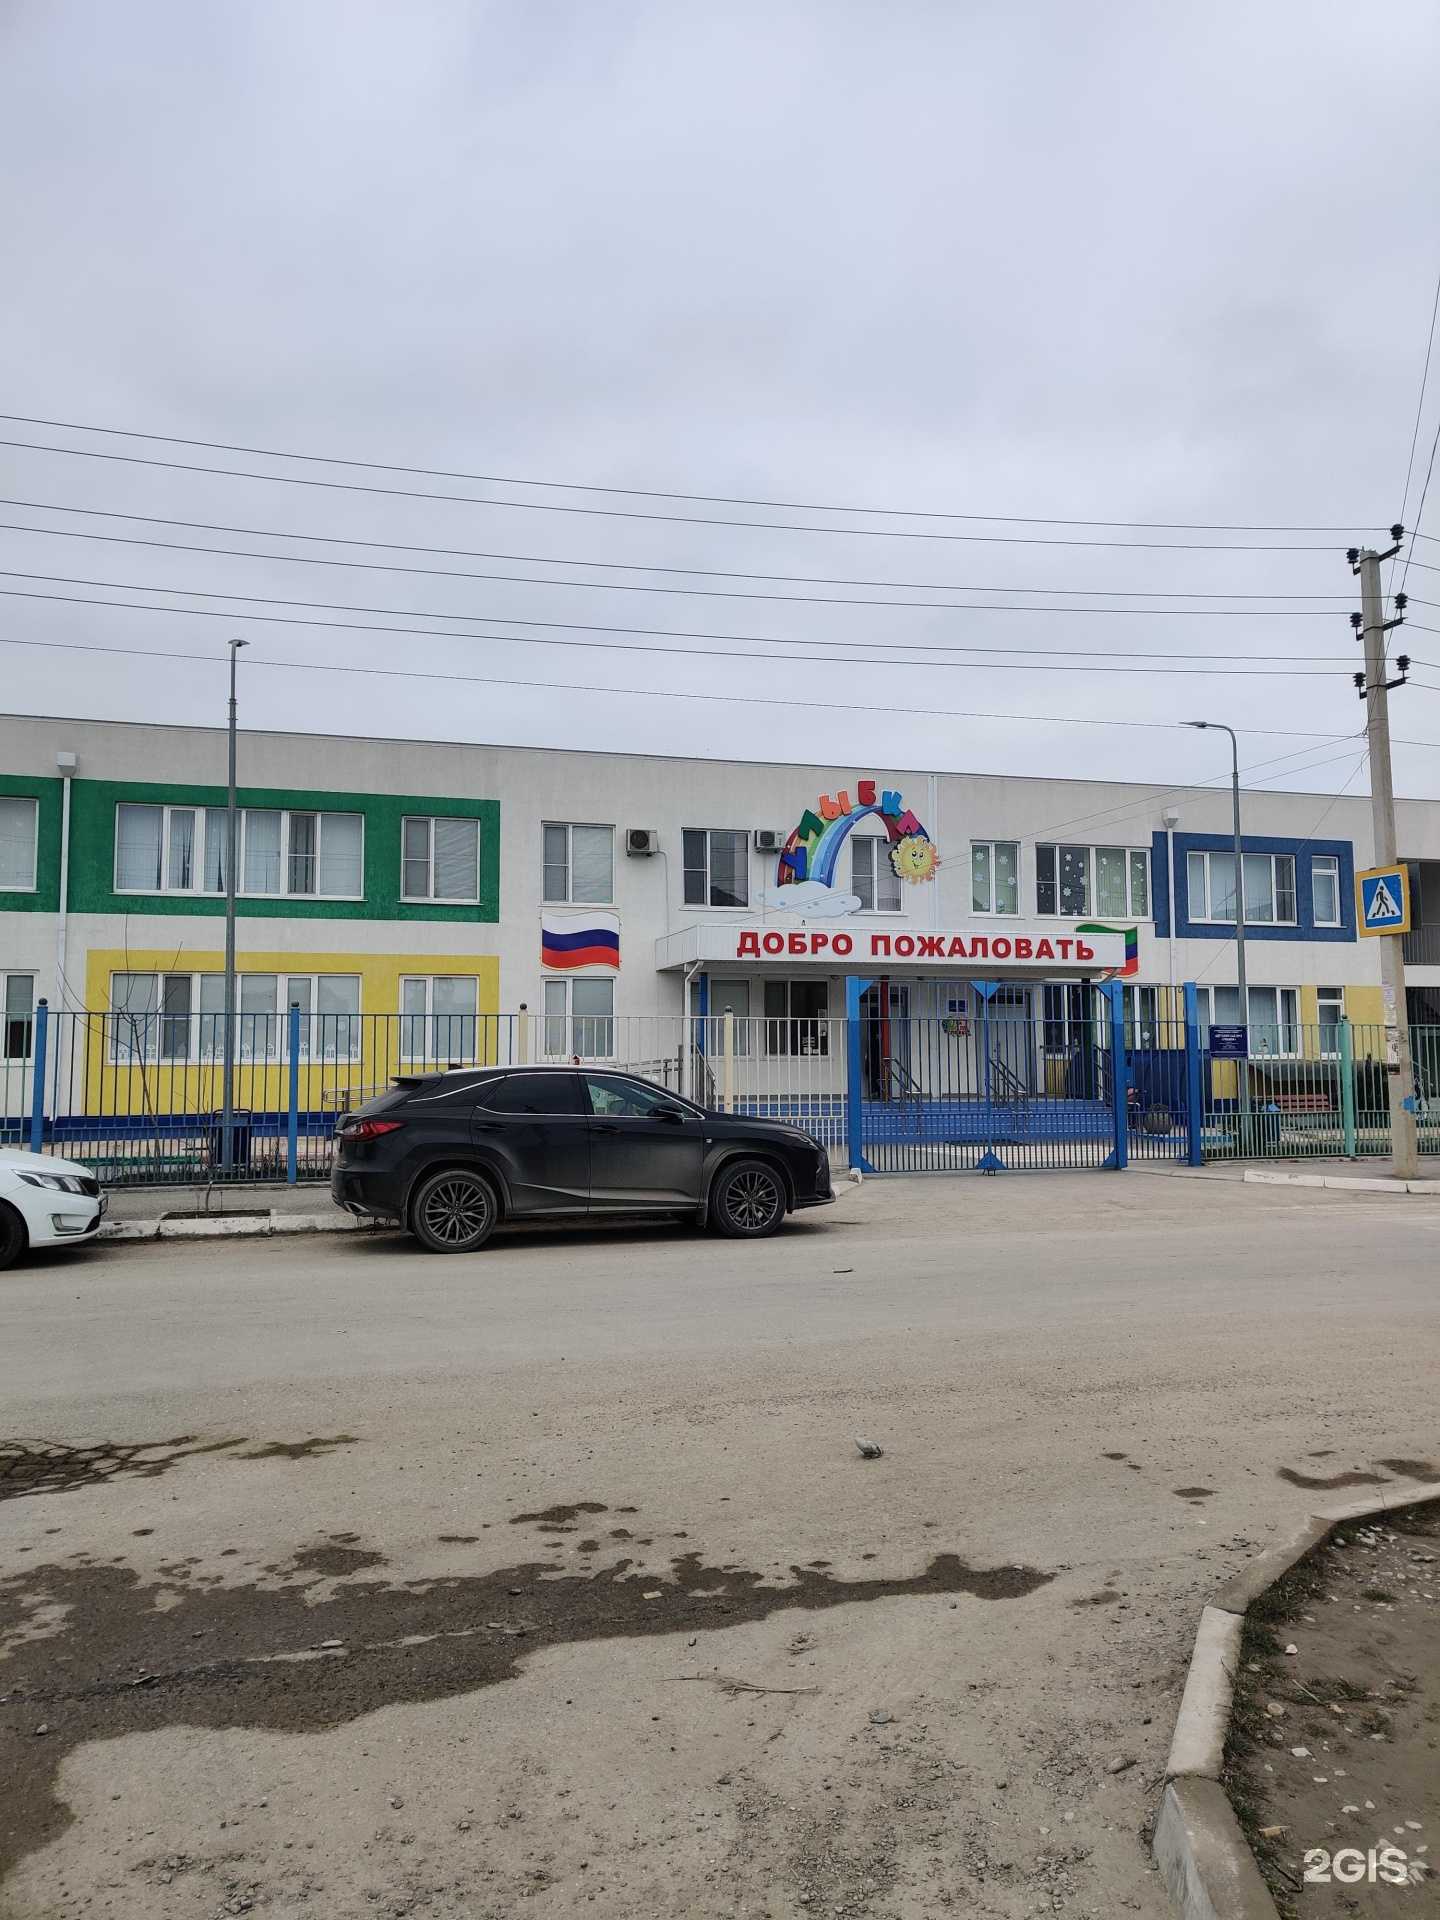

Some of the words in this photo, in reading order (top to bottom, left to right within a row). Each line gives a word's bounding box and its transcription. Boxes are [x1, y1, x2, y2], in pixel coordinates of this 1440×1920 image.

[783, 780, 920, 881] УЛЫБКА
[736, 931, 853, 958] ДОБРО
[871, 935, 1094, 961] ПОЖАЛОВАТЬ
